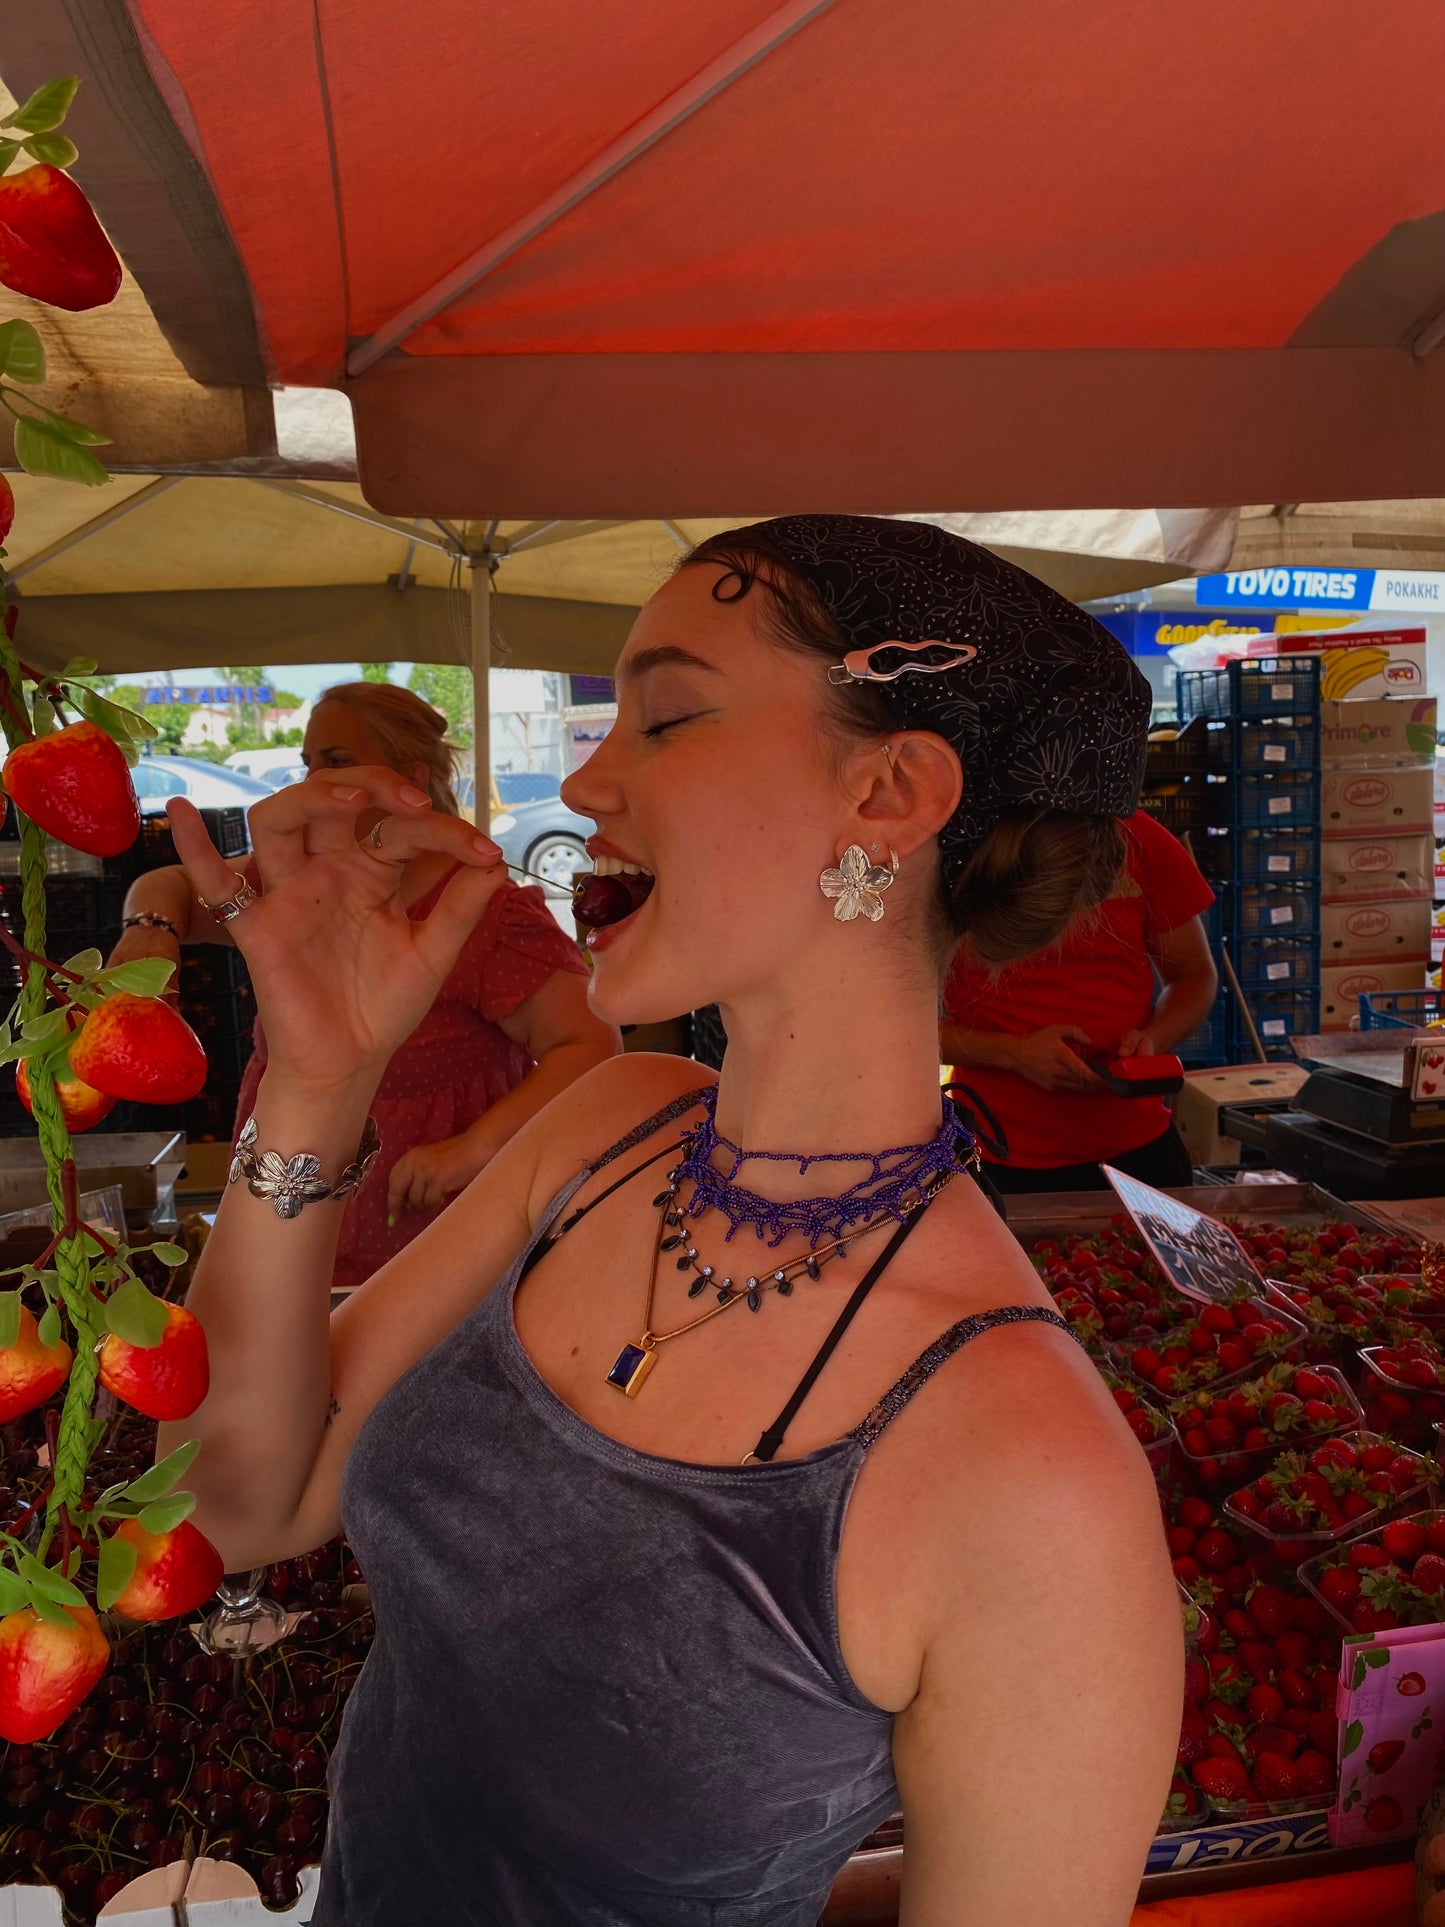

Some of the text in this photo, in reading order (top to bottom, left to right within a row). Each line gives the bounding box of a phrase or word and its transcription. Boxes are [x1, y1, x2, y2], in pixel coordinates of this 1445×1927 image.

[1225, 569, 1357, 600] TOYO TIRES
[1386, 580, 1439, 600] ΡΟΚΑΚΗΣ
[1388, 667, 1414, 681] Dole
[146, 686, 272, 704] ATLANTIS
